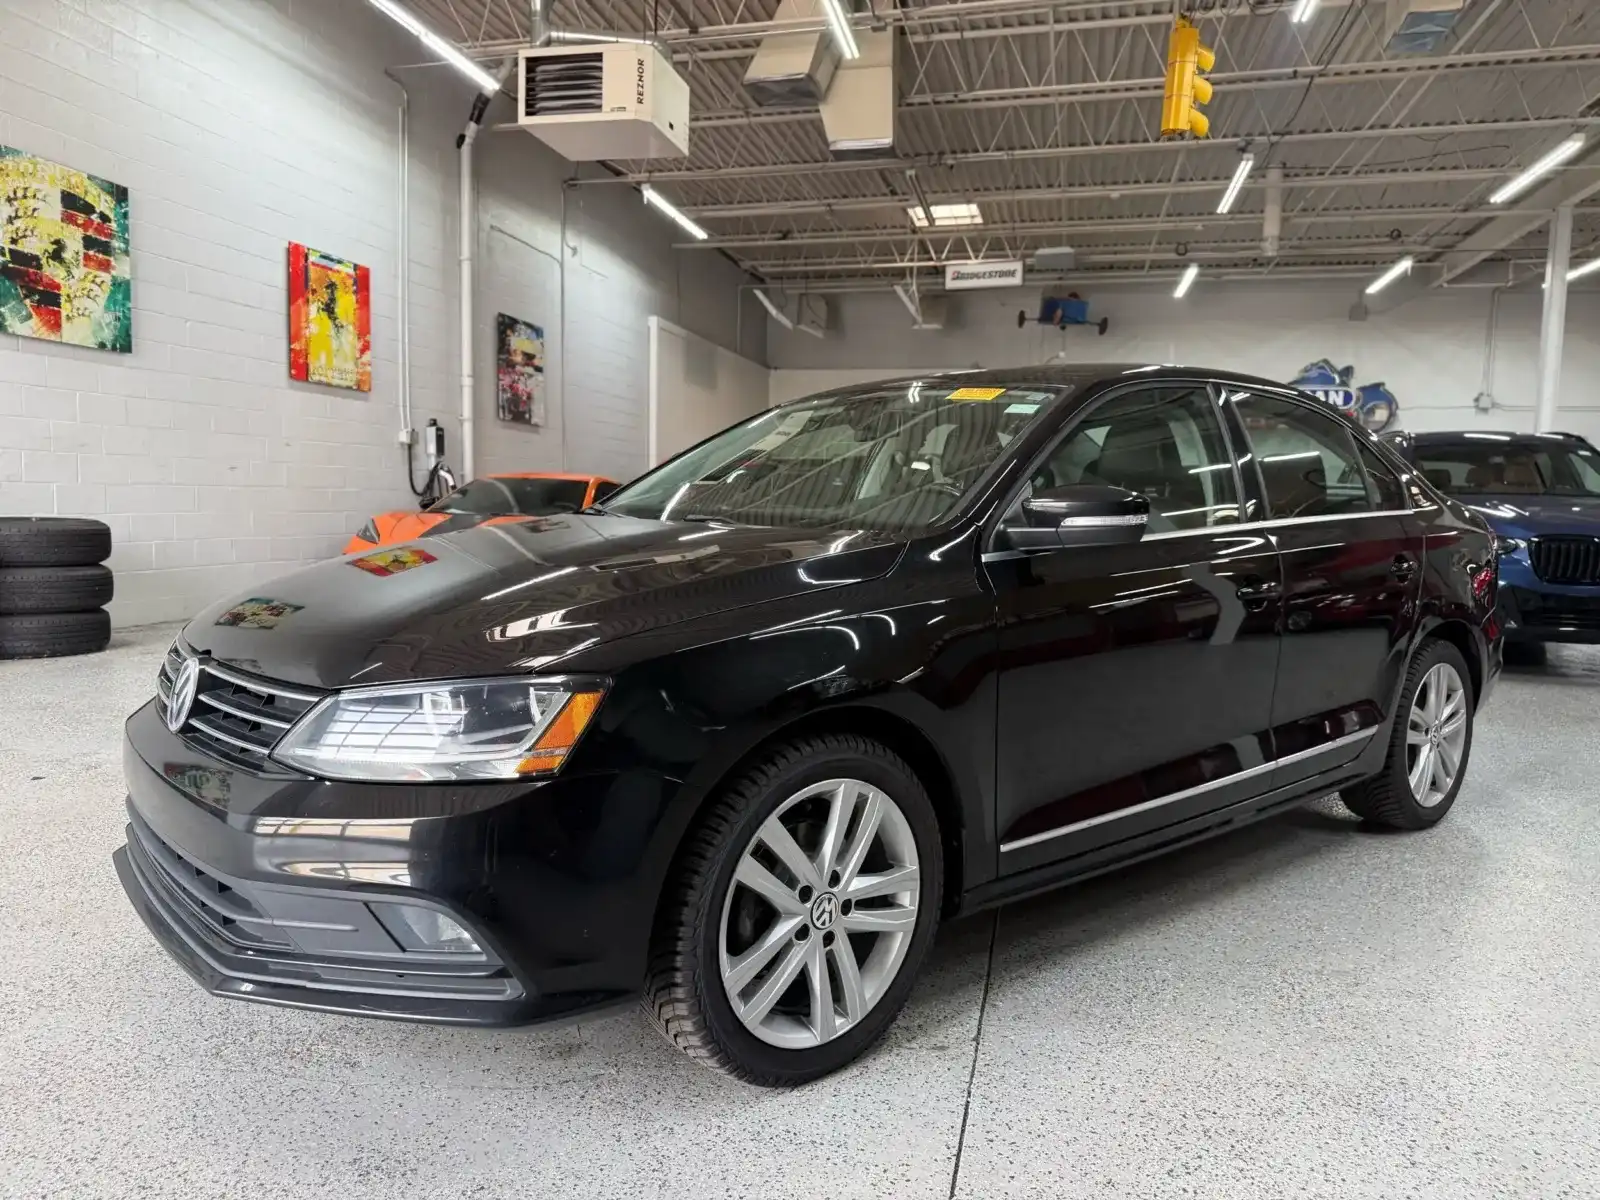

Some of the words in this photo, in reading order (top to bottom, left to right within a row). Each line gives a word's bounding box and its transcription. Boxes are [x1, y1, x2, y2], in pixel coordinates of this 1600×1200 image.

[636, 58, 645, 105] REZNOR
[951, 269, 1018, 281] BRIDGESTONE
[1305, 390, 1345, 408] AN
